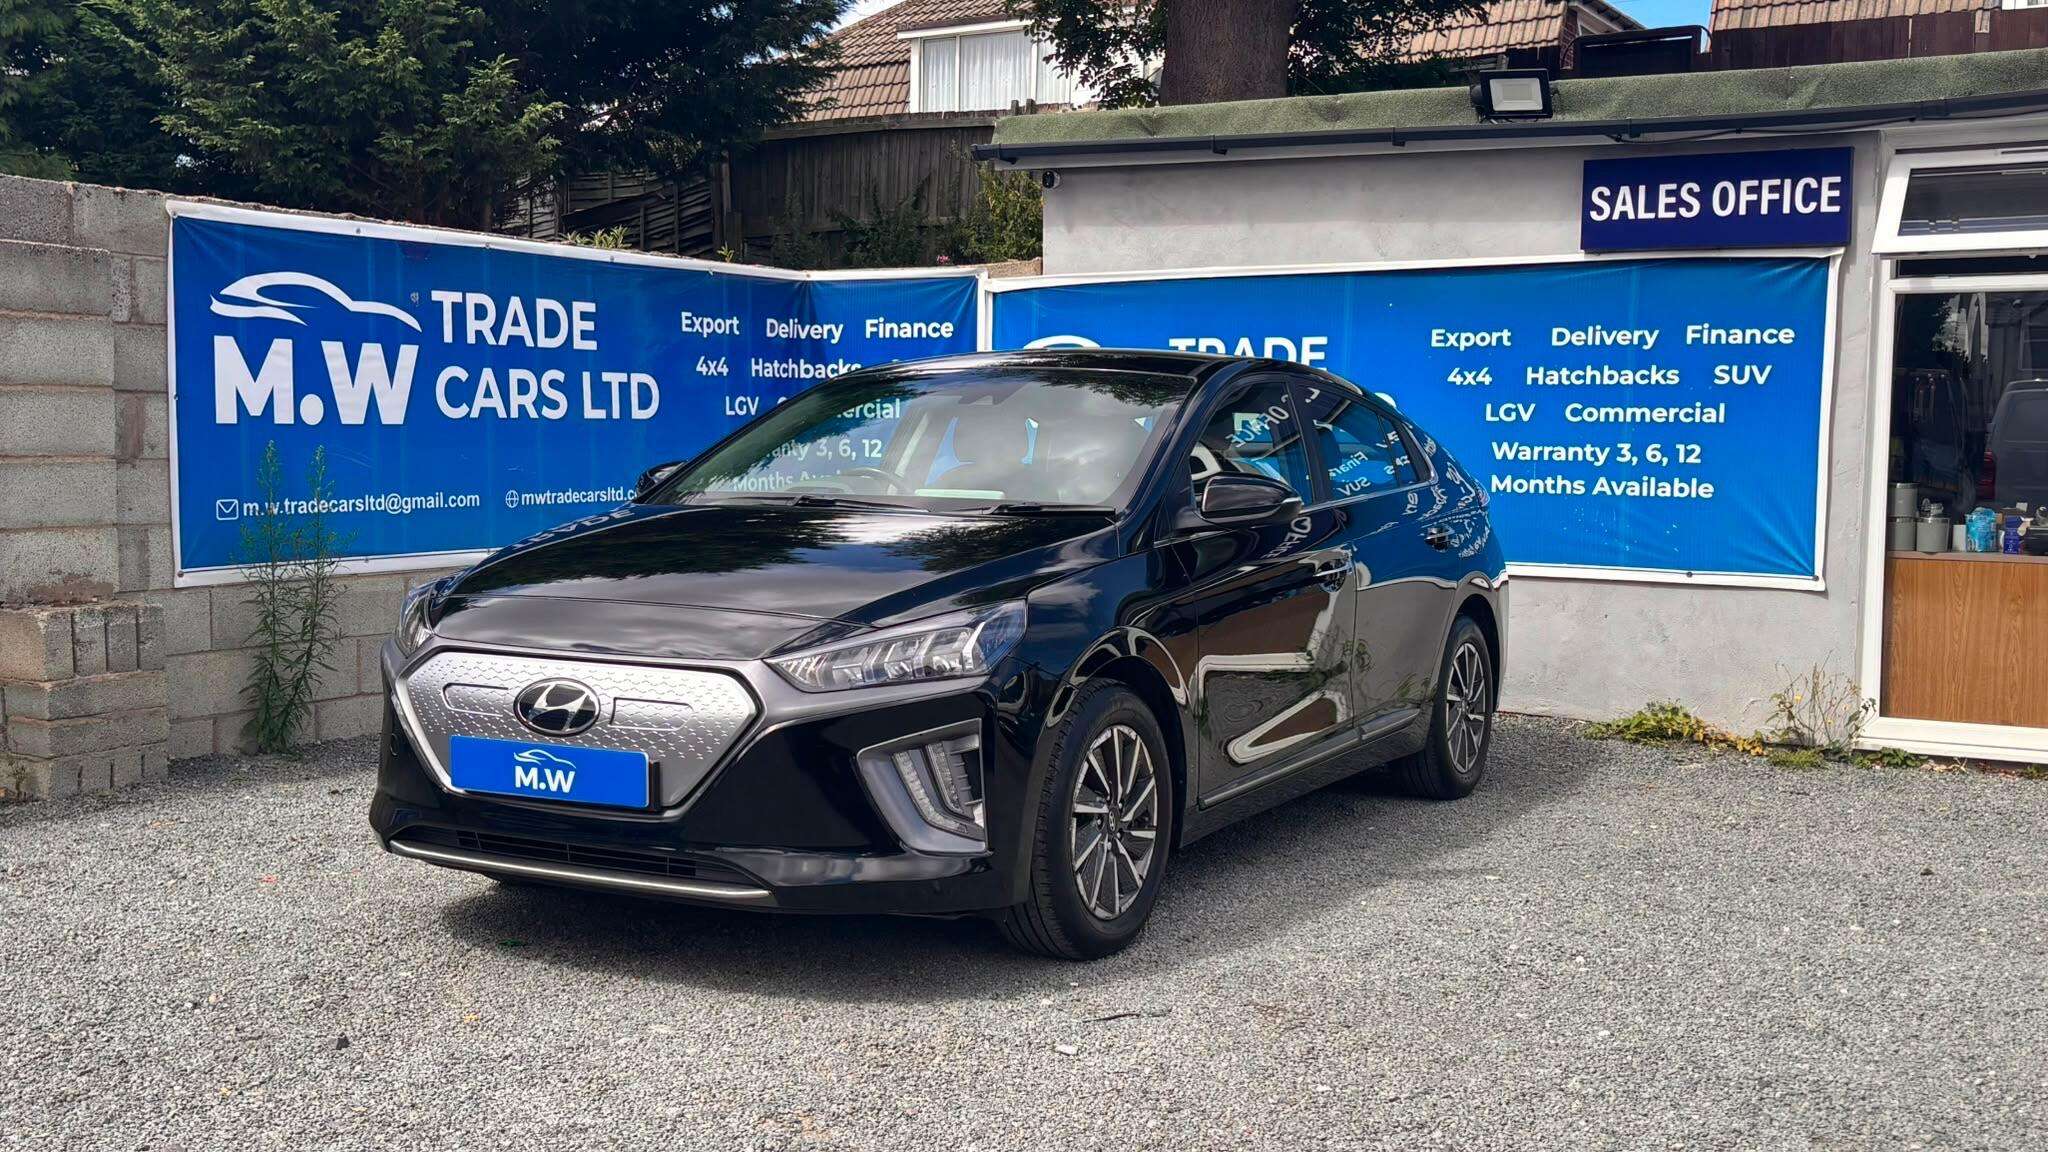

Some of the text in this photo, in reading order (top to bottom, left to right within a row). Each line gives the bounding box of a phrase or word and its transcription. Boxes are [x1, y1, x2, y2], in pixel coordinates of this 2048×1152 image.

[1589, 176, 1842, 222] SALES OFFICE
[431, 290, 598, 351] TRADE
[681, 311, 954, 344] Export Delivery Finance
[1430, 323, 1795, 351] Export Delivery Finance
[696, 356, 729, 376] 4x4
[1447, 364, 1772, 386] 4x4 Hatchbacks SUV
[213, 335, 420, 426] M.W
[435, 367, 660, 420] CARS LTD
[726, 396, 759, 416] LGV
[1485, 402, 1725, 424] LGV Commercial
[862, 438, 882, 458] 12
[1491, 441, 1702, 467] Warranty 3, 6, 12
[1490, 474, 1586, 496] Months
[1591, 475, 1715, 499] Available
[514, 766, 576, 794] M.W
